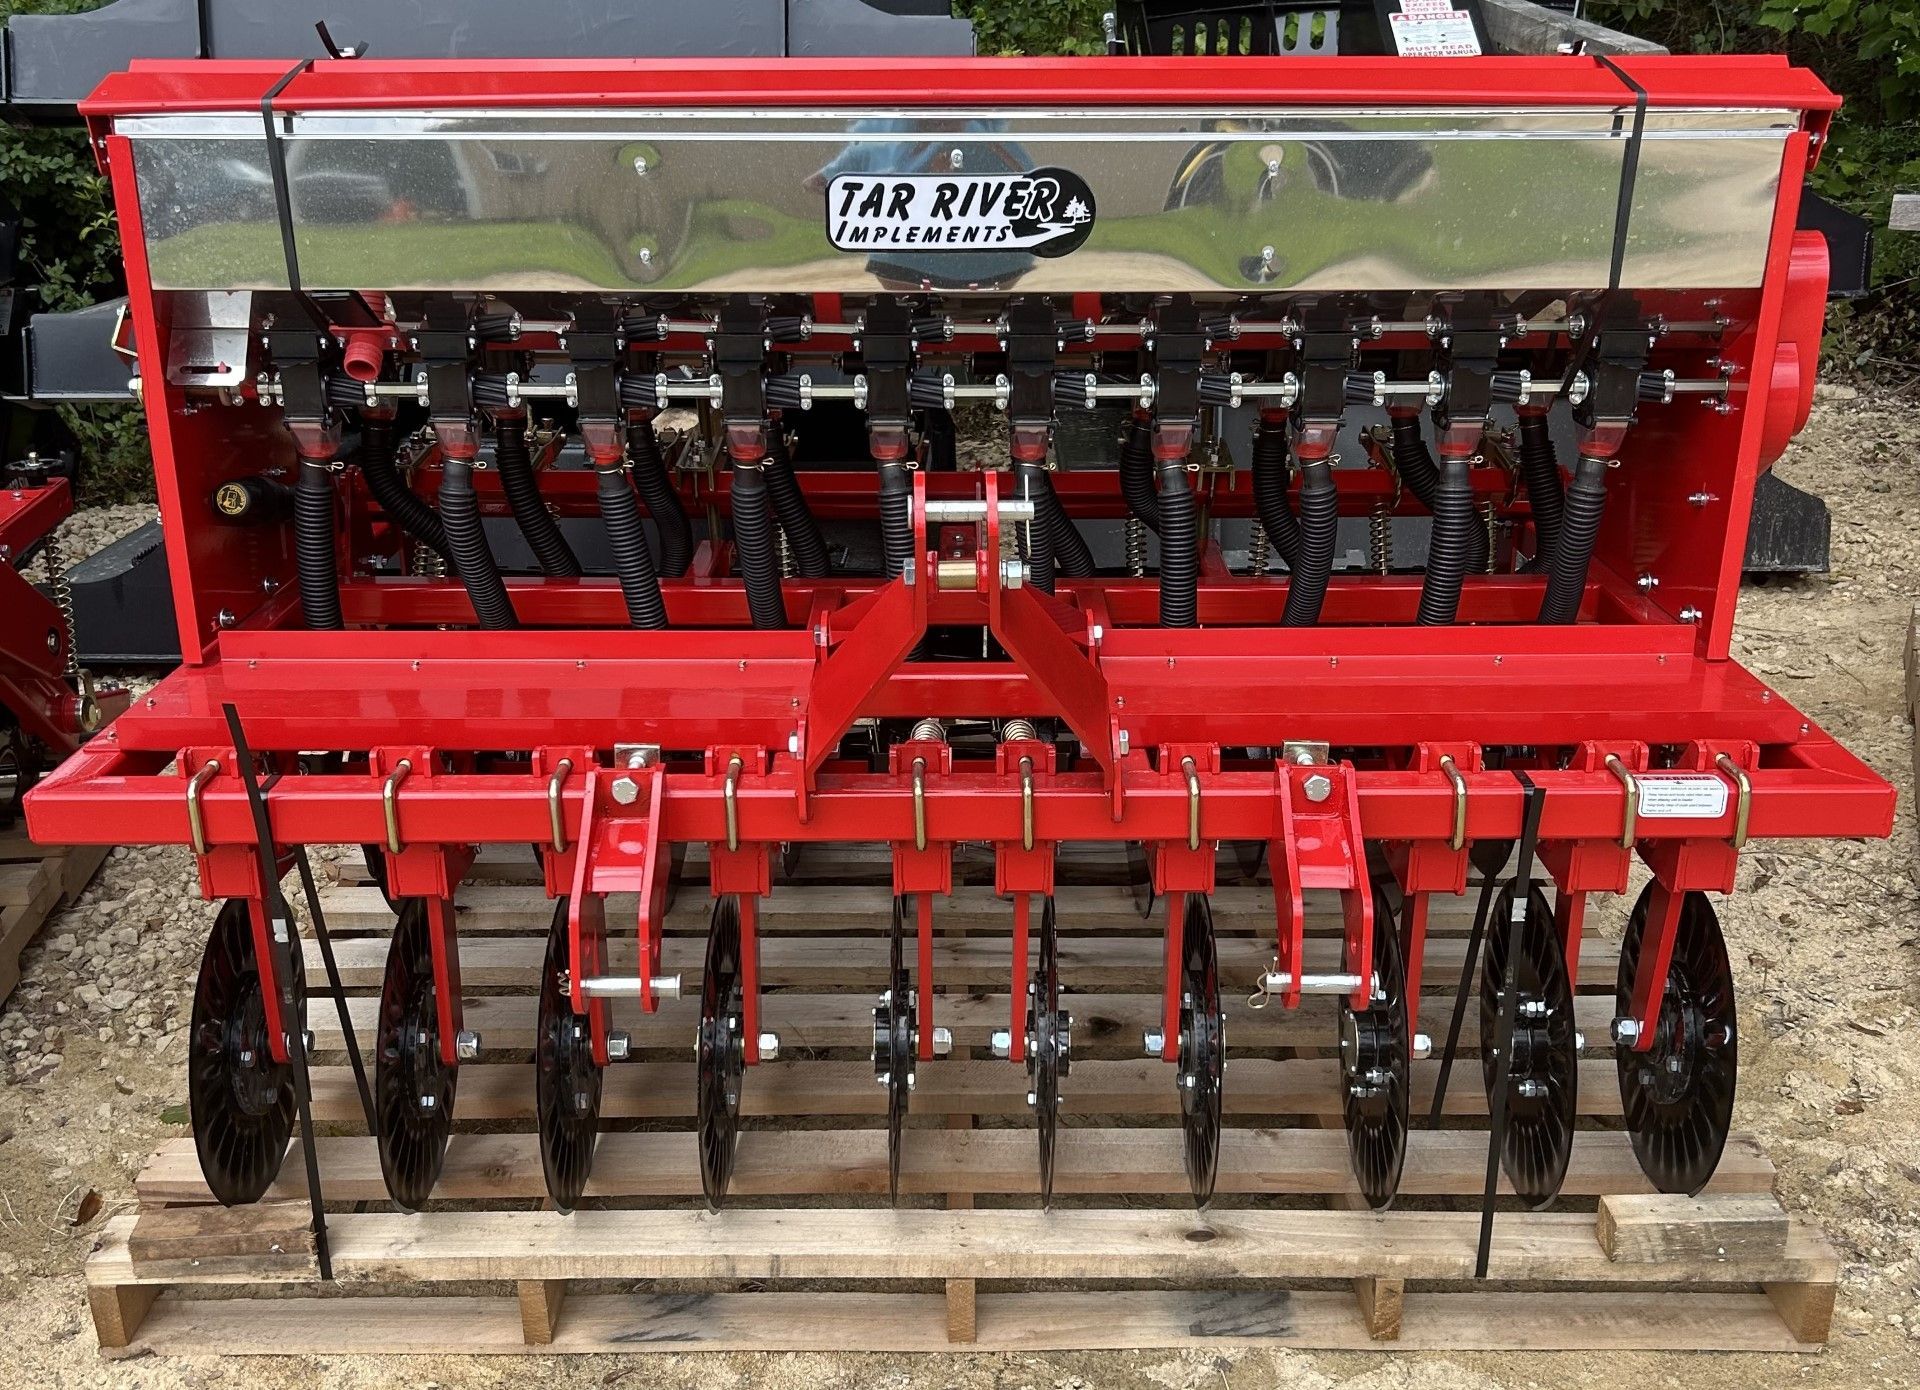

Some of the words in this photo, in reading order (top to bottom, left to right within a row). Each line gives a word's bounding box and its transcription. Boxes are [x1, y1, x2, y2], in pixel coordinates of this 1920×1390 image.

[838, 182, 915, 221] TAR
[930, 180, 1059, 222] RIVER
[835, 220, 1011, 244] IMPLEMENTS
